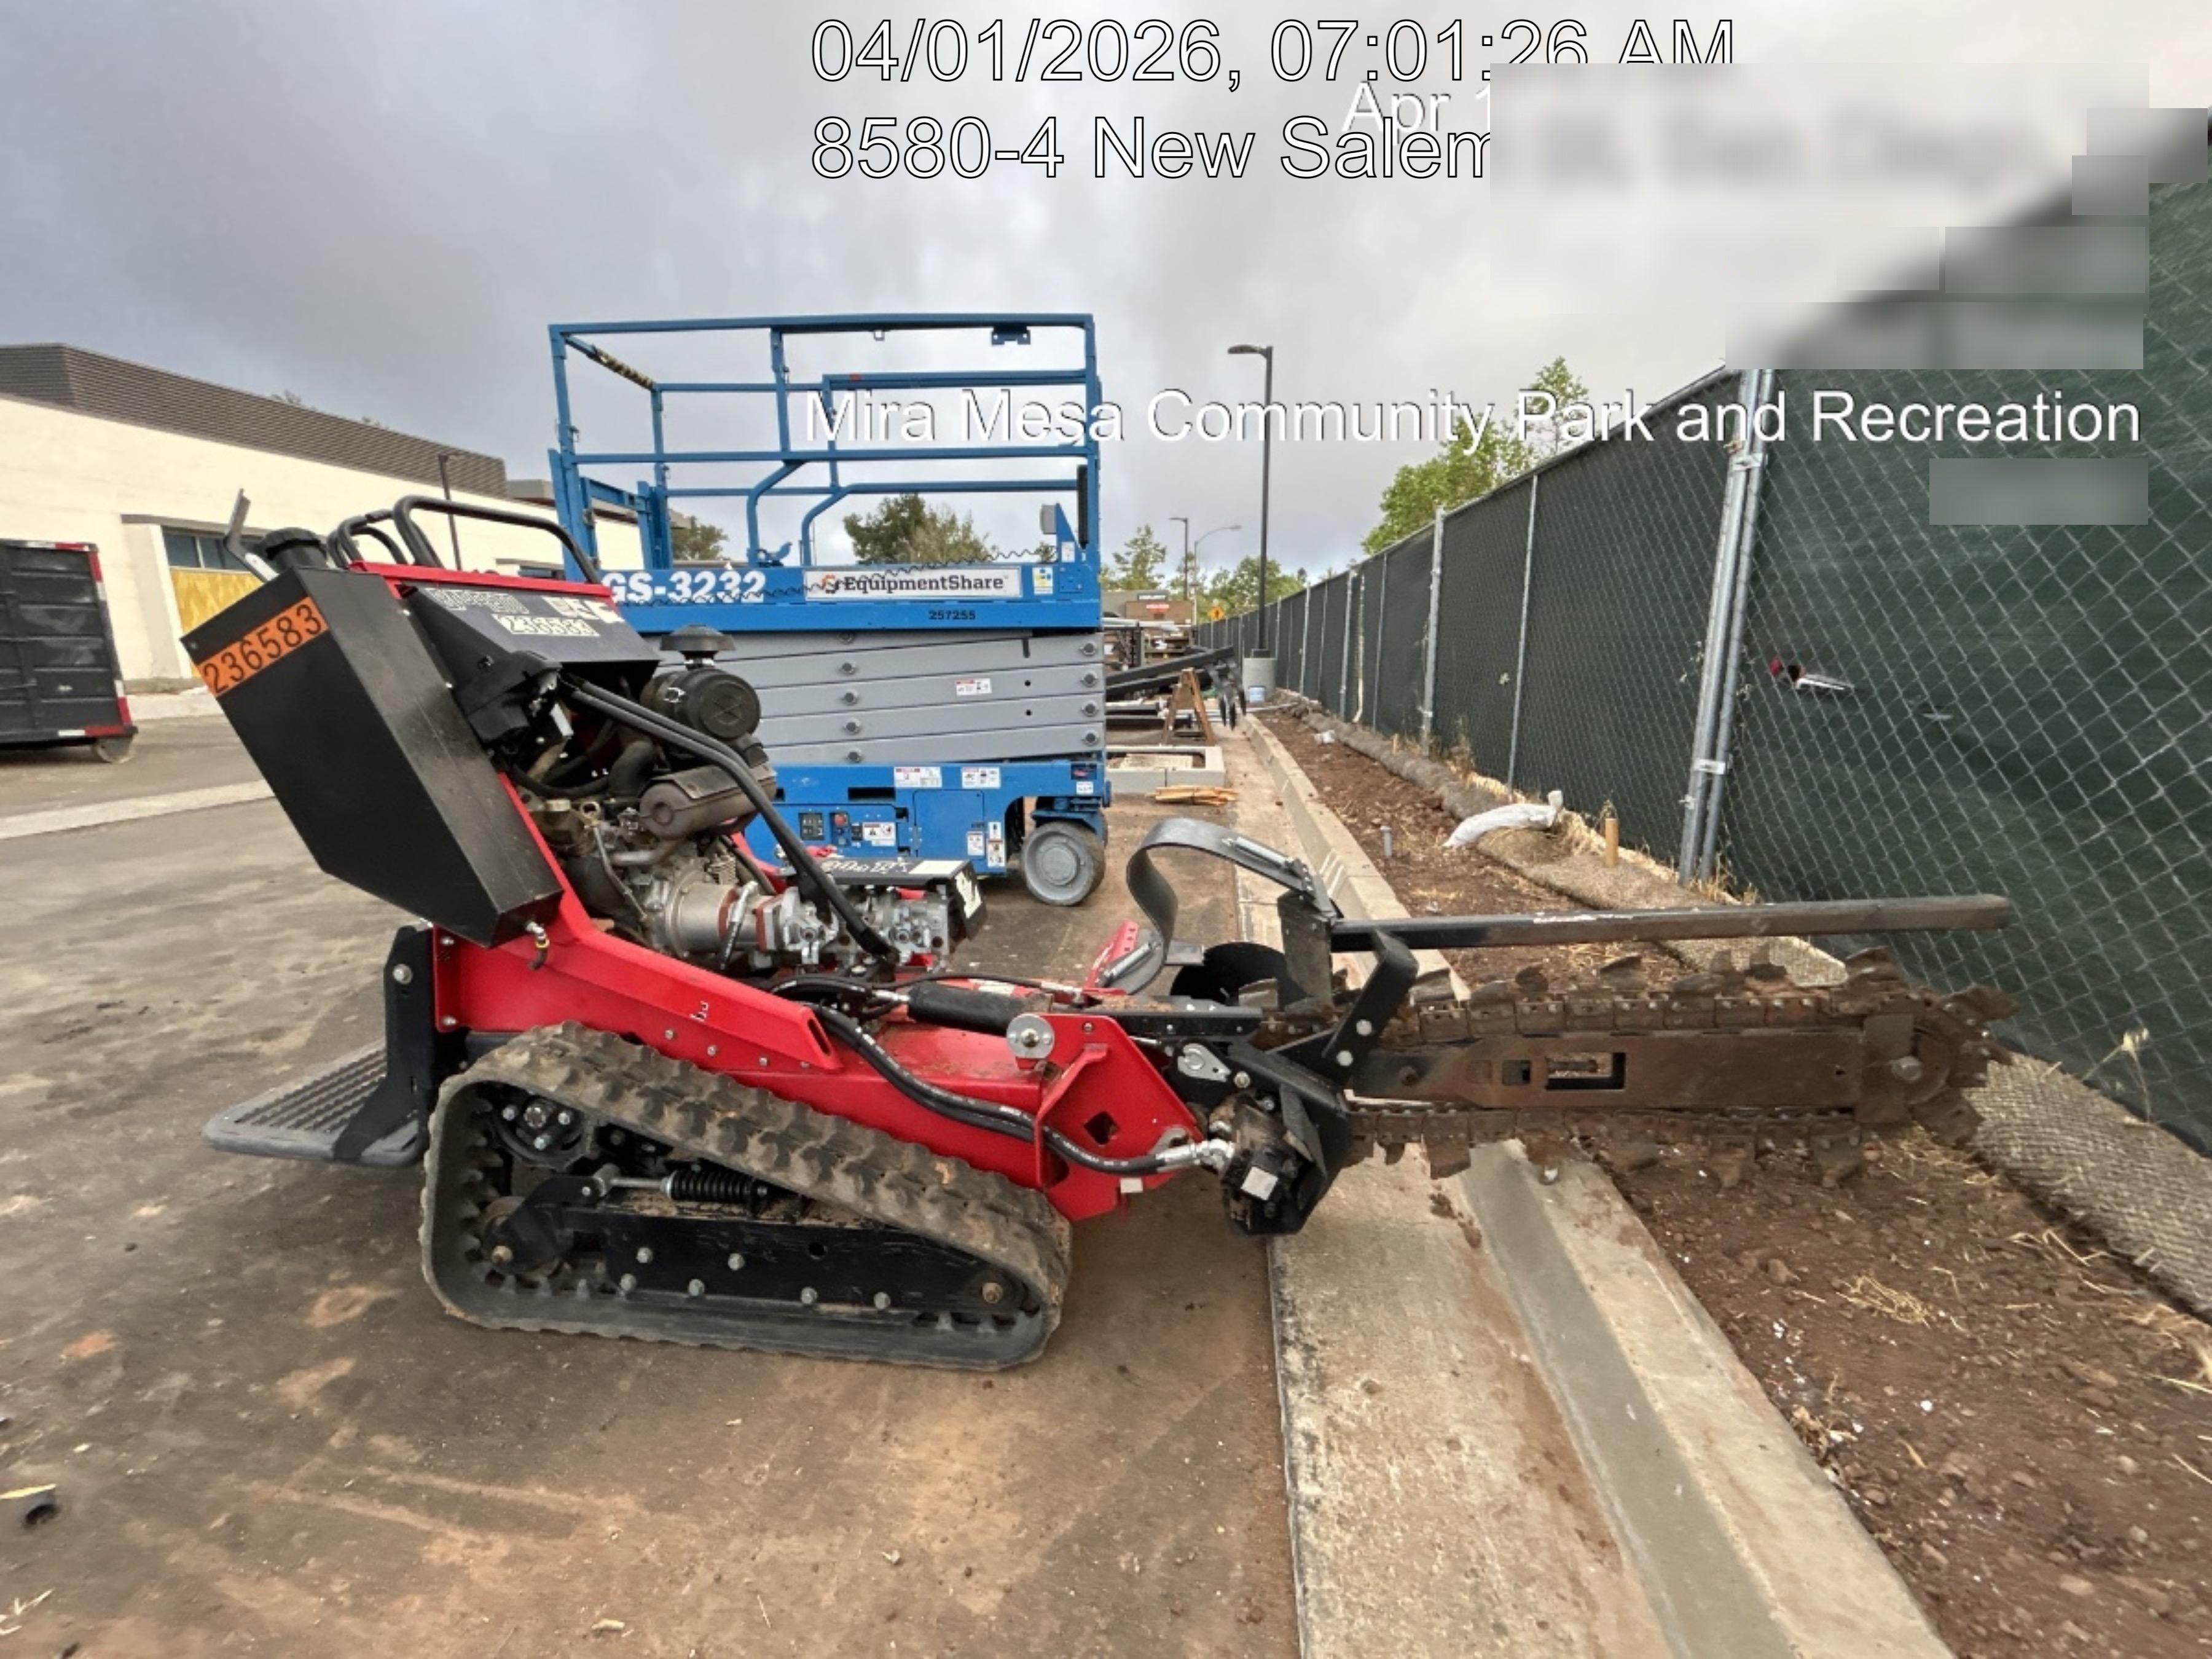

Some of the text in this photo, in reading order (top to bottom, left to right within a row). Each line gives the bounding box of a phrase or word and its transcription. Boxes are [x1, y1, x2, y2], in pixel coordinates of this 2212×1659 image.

[602, 570, 766, 605] GS-3232
[844, 574, 1003, 594] EquipmentShare
[928, 611, 976, 620] 257255
[203, 604, 321, 694] 236583
